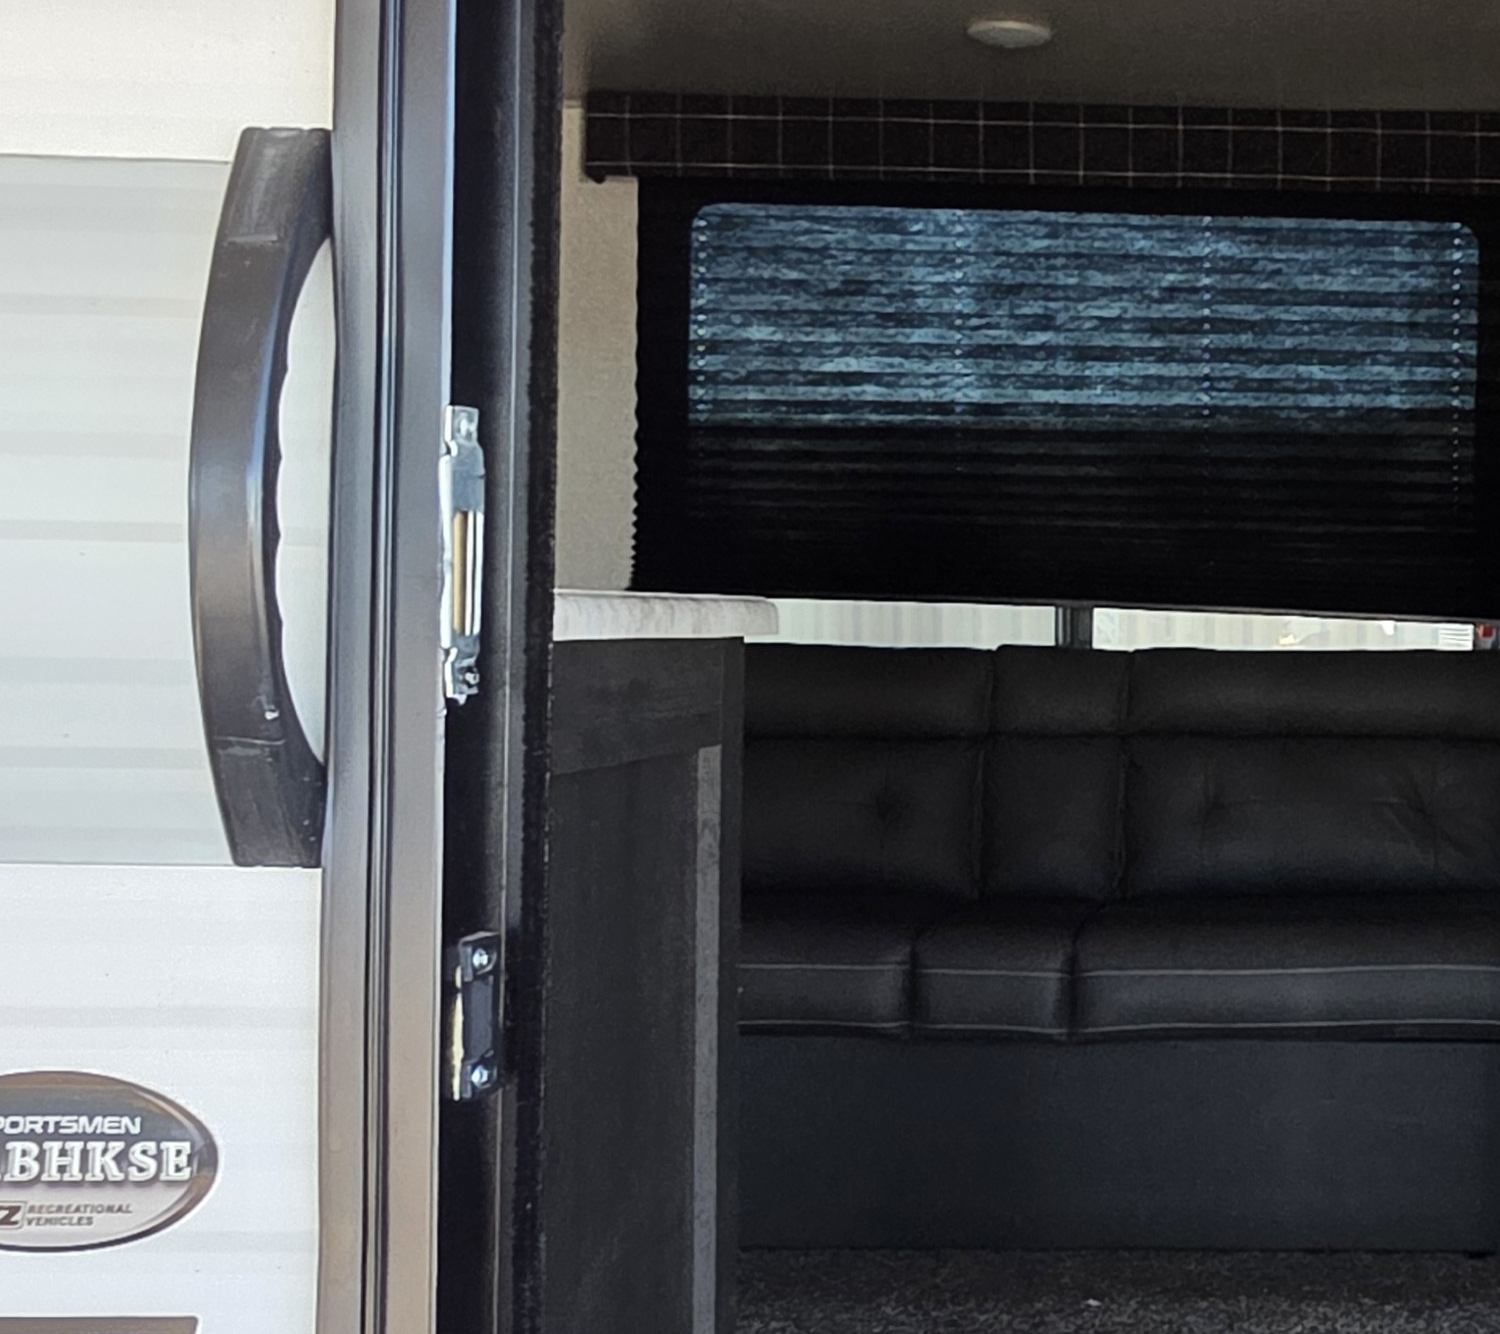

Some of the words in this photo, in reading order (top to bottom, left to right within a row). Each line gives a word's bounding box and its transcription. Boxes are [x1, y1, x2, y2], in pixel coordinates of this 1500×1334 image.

[0, 1116, 141, 1134] ORTSMEN
[0, 1140, 192, 1181] BHKSE
[0, 1205, 21, 1226] Z
[27, 1204, 132, 1214] RECREATIONAL
[25, 1216, 94, 1226] VEHICLES
